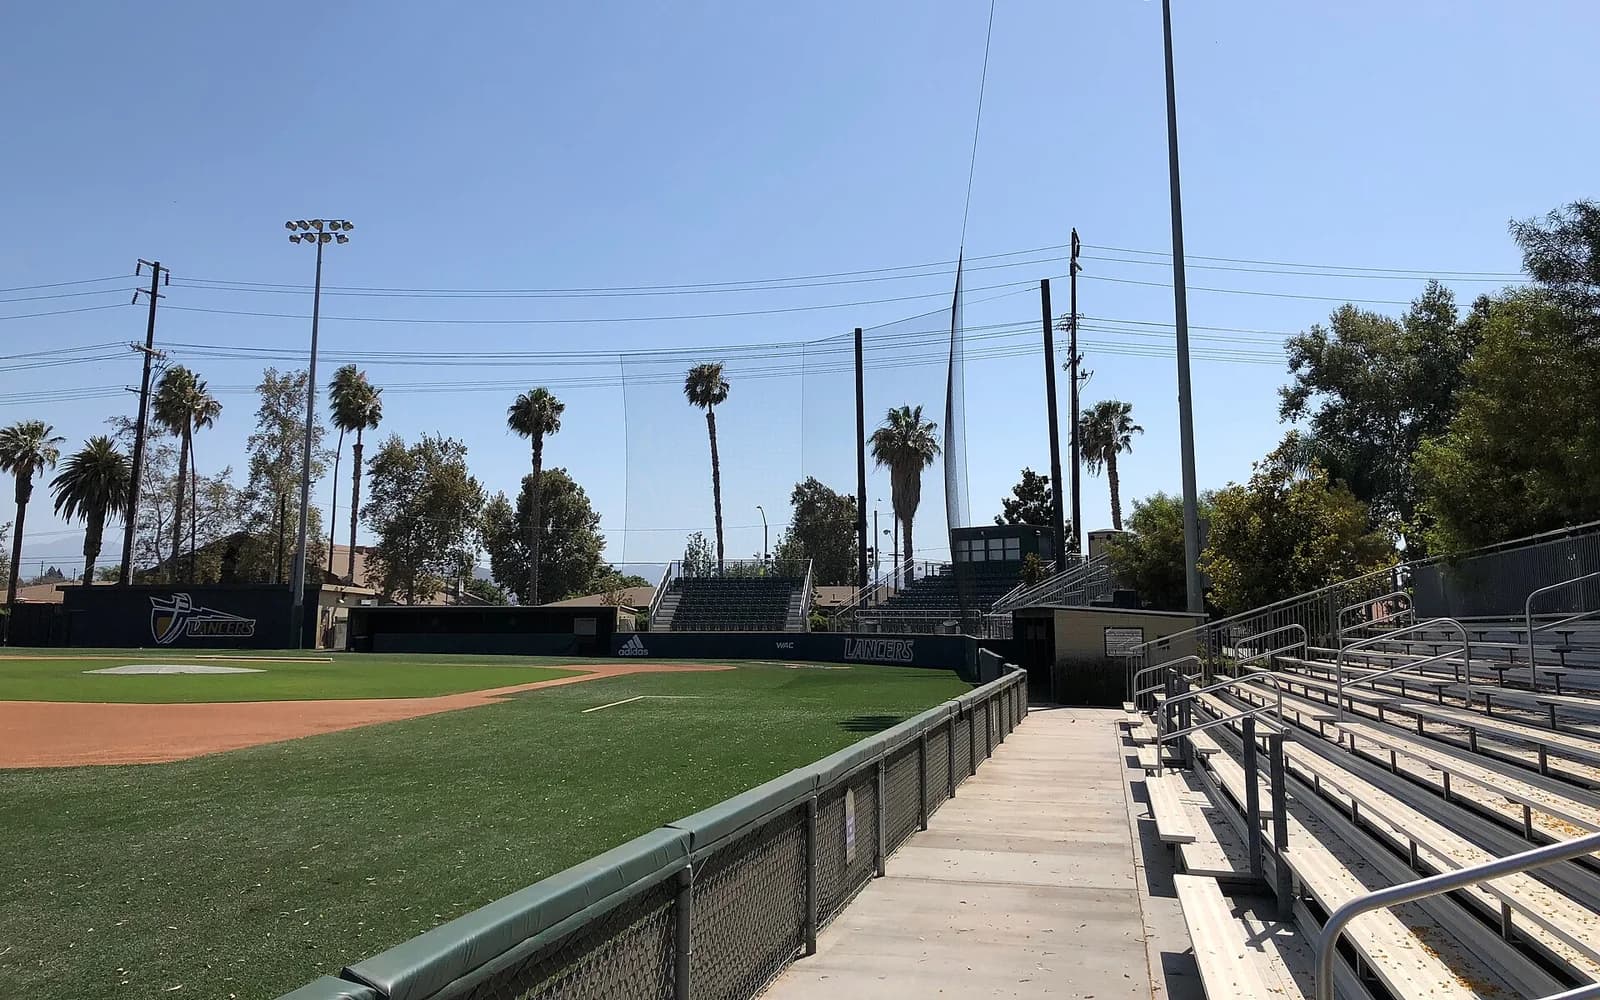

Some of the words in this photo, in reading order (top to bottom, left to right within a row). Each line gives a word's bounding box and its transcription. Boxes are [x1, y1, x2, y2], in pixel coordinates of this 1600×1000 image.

[188, 620, 254, 635] LANCERS
[618, 648, 649, 656] adidas
[844, 639, 913, 661] LANCERS
